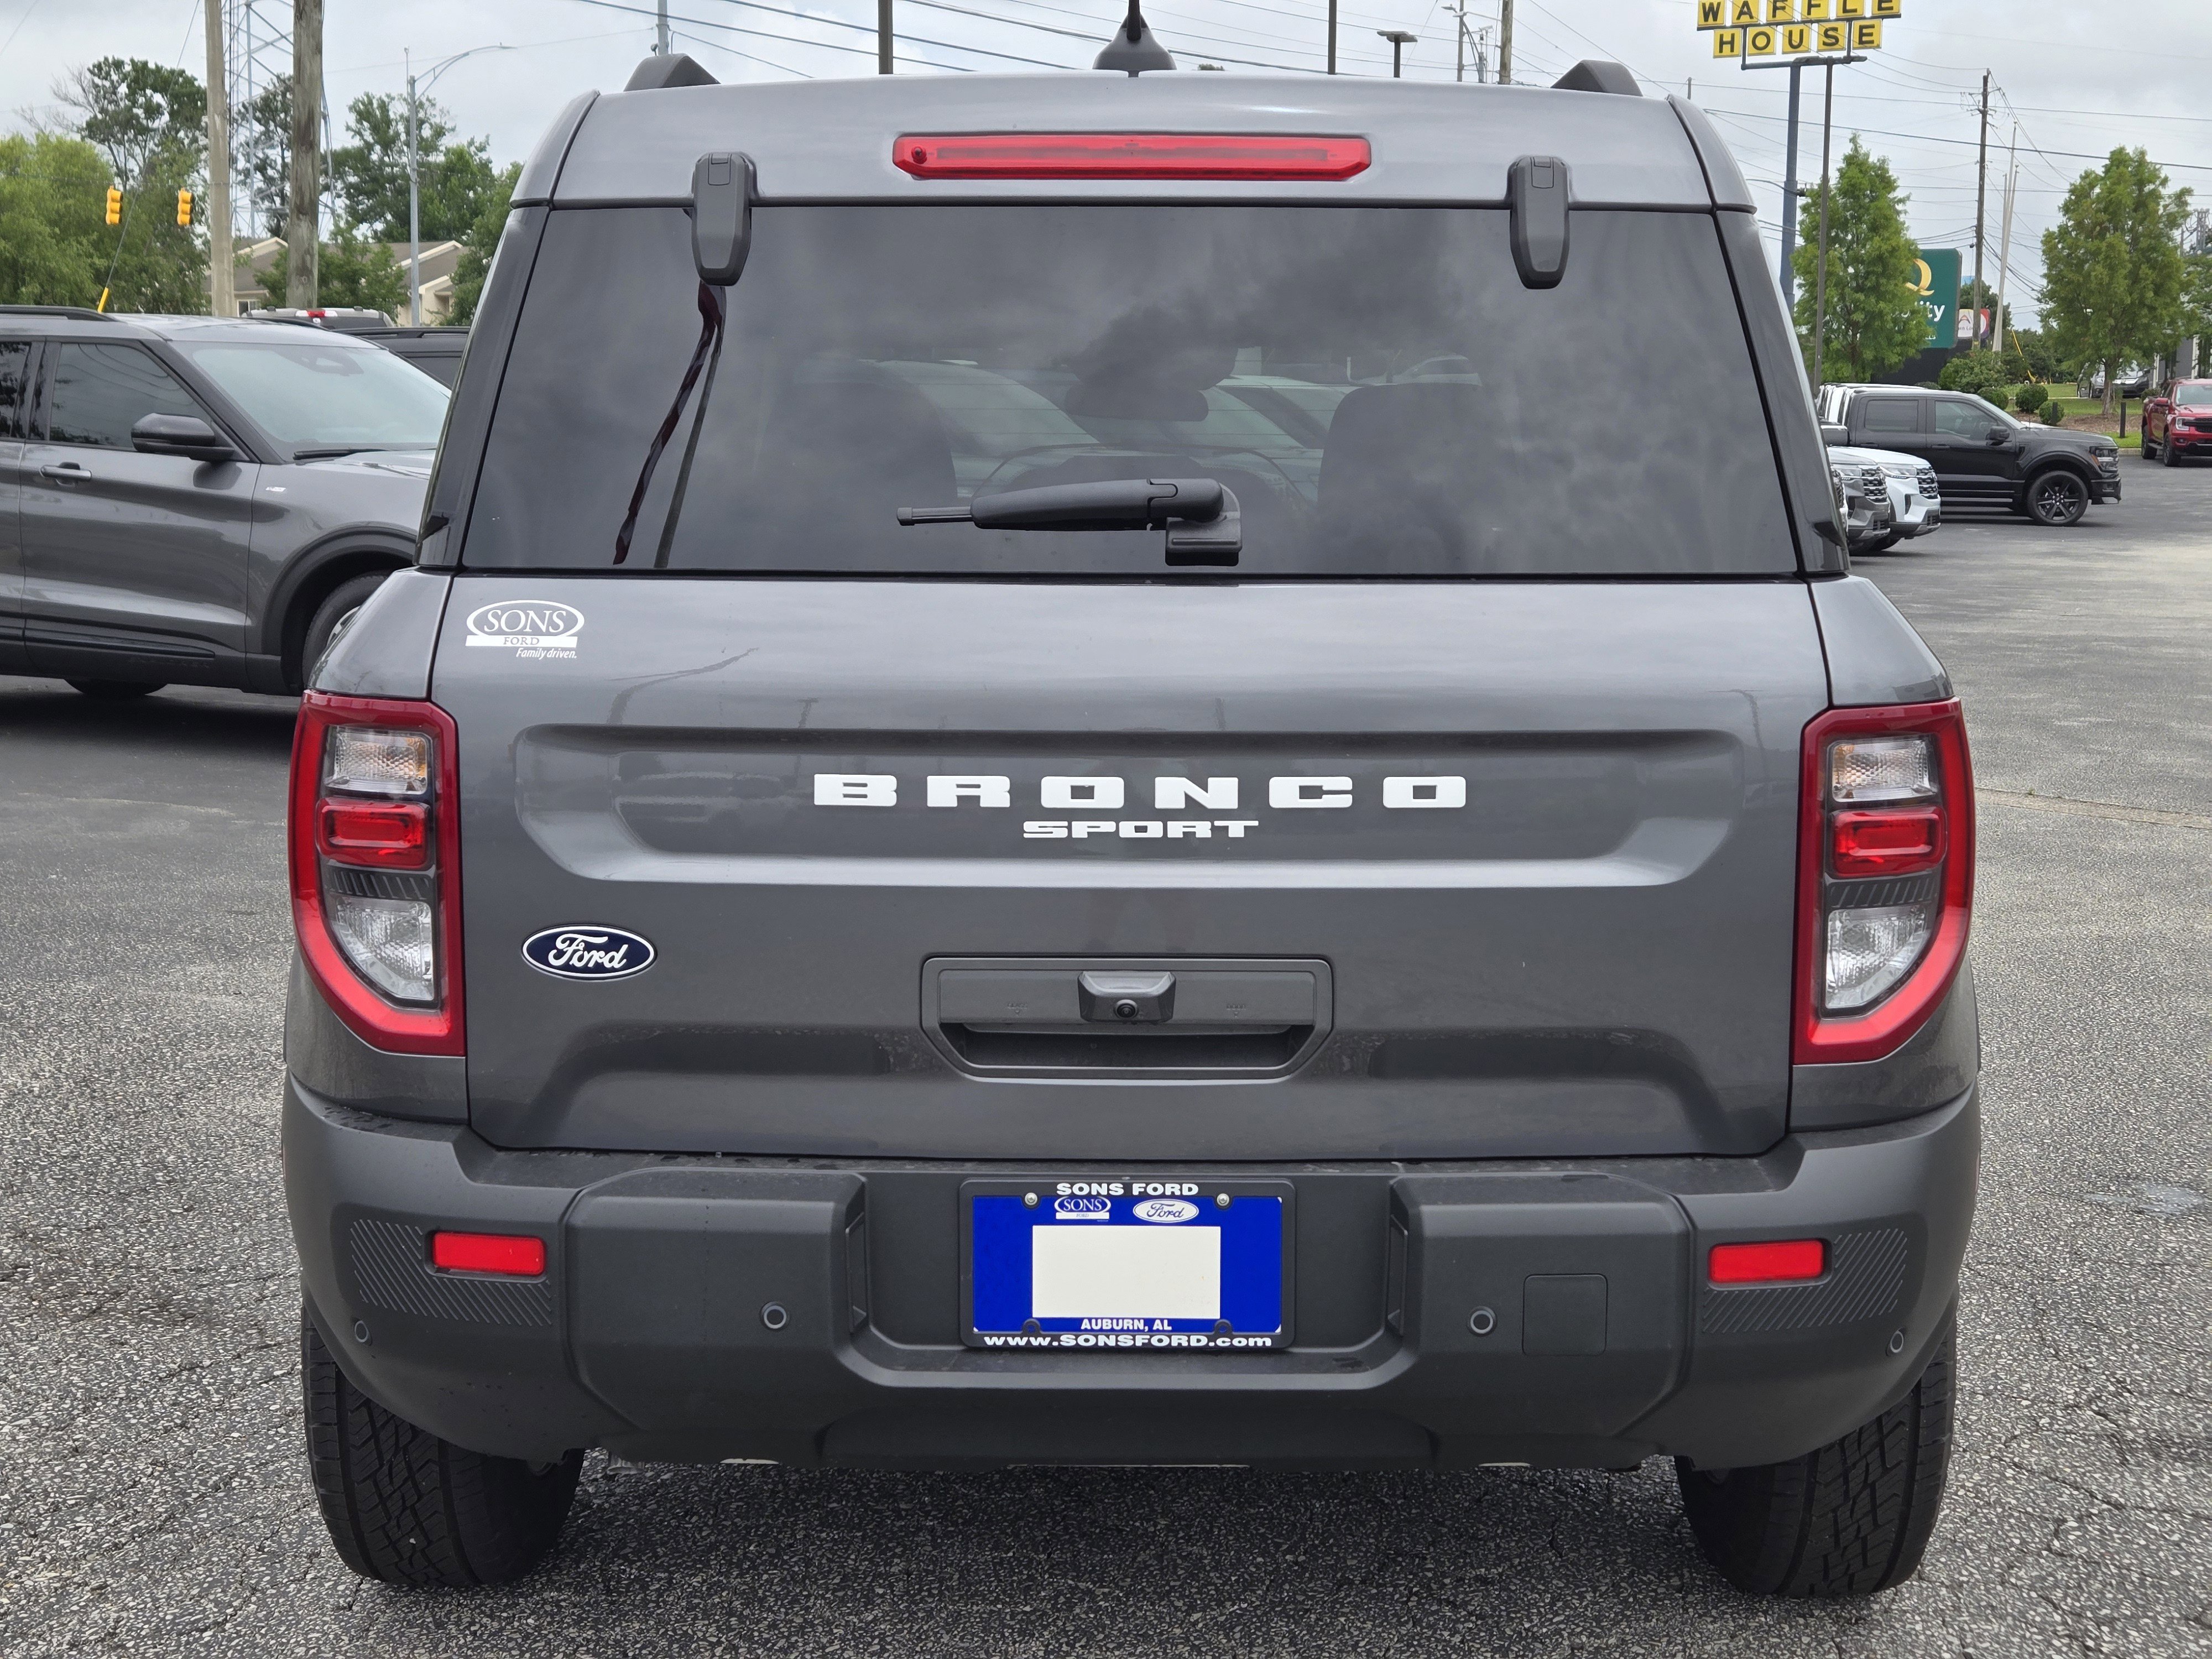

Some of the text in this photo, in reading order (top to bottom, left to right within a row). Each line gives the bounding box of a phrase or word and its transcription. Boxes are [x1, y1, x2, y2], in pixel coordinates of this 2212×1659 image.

[1702, 0, 1894, 23] WAFFLE
[1718, 24, 1875, 53] HOUSE
[484, 609, 566, 633] SONS
[503, 637, 540, 645] FORD
[516, 648, 577, 660] Family driven.
[813, 774, 1466, 810] BRONCO
[1023, 821, 1259, 838] SPORT
[547, 933, 628, 968] Ford
[1057, 1183, 1199, 1196] SONS FORD
[1063, 1198, 1102, 1211] SONS
[1146, 1202, 1185, 1218] Ford
[1081, 1319, 1172, 1332] AUBURN, AL
[984, 1334, 1272, 1347] www.SONSFORD.com
